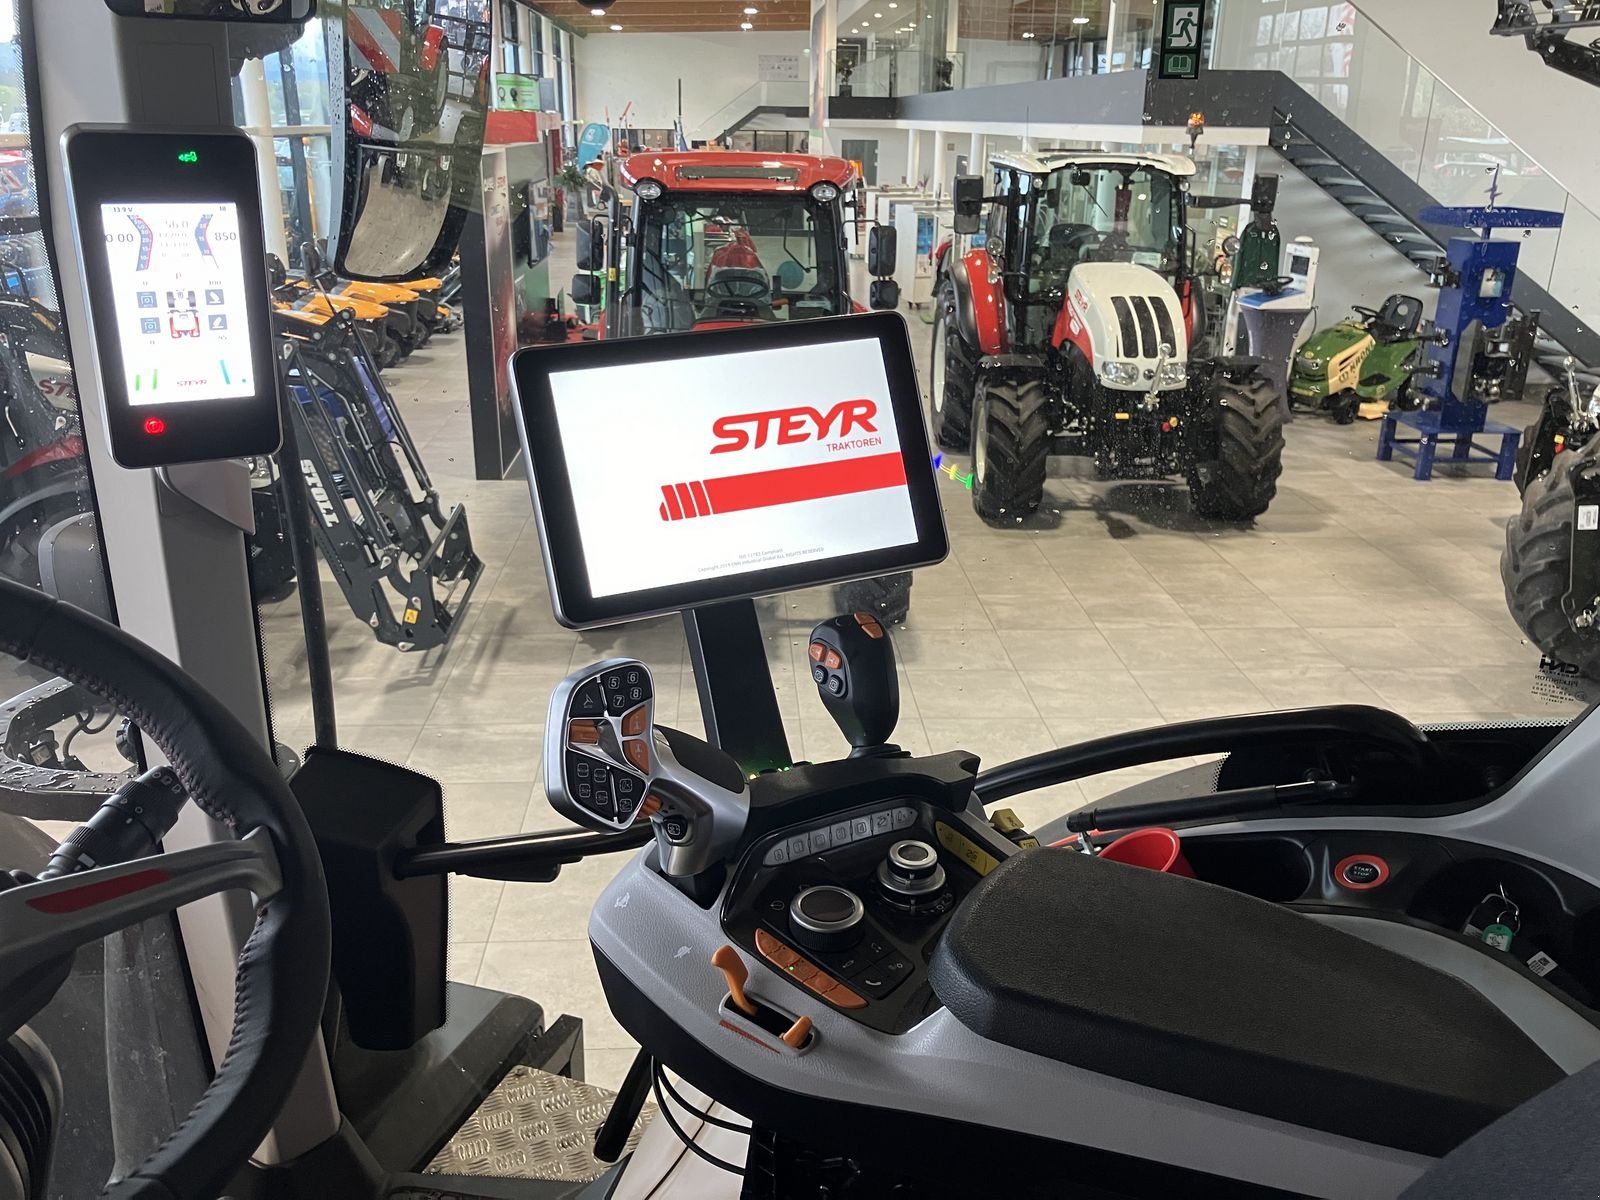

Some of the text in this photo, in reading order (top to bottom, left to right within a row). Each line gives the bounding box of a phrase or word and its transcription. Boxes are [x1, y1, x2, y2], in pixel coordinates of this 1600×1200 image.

[214, 231, 238, 241] 850
[709, 399, 878, 455] STEYR
[826, 436, 883, 453] TRAKTOREN
[300, 459, 340, 528] STOLL
